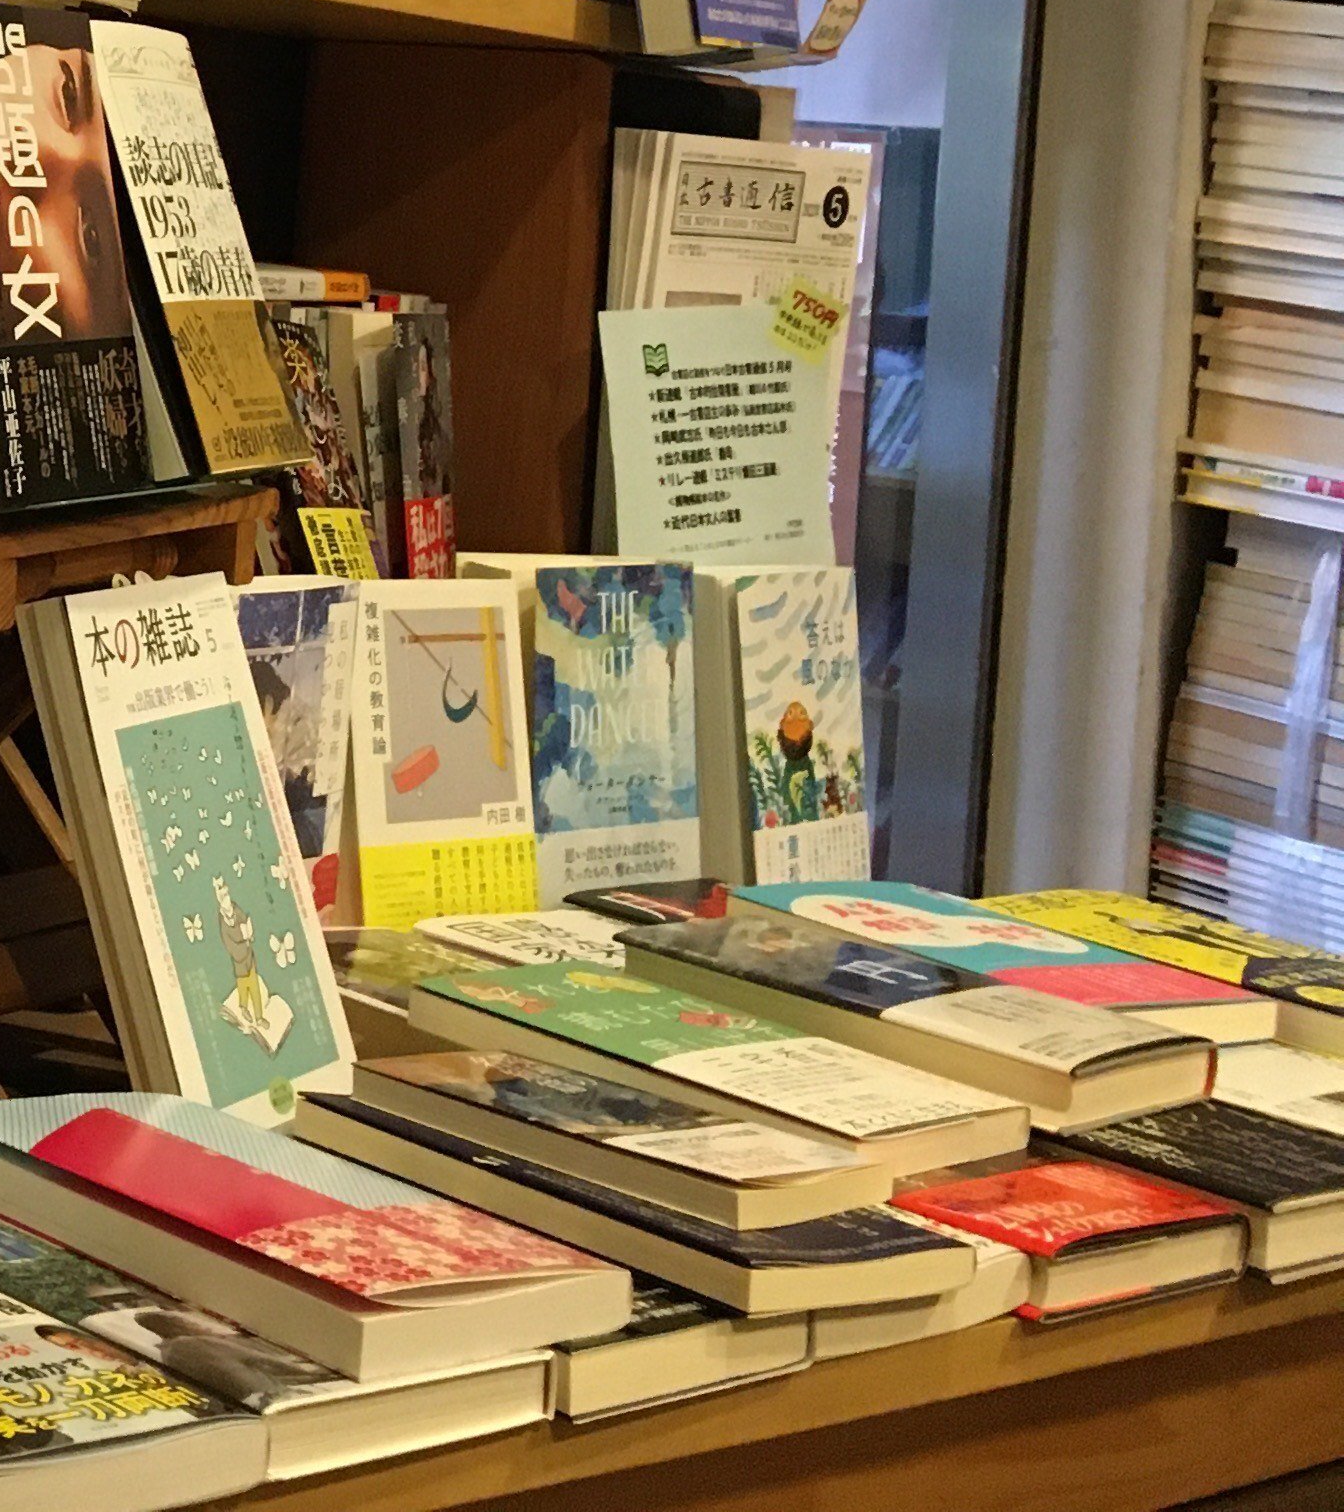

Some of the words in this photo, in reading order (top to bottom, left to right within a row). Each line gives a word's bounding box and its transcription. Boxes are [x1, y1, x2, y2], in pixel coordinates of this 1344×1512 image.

[121, 134, 224, 192] 談志の日記
[140, 194, 198, 241] 1953
[695, 177, 796, 213] 古書通信
[155, 247, 253, 304] 17歳の青春
[791, 288, 841, 329] 750円
[596, 589, 640, 636] THE
[805, 620, 845, 650] 答えは
[83, 601, 201, 679] 本の雑誌
[204, 628, 218, 655] 5
[364, 600, 388, 757] 複雑化の教育論
